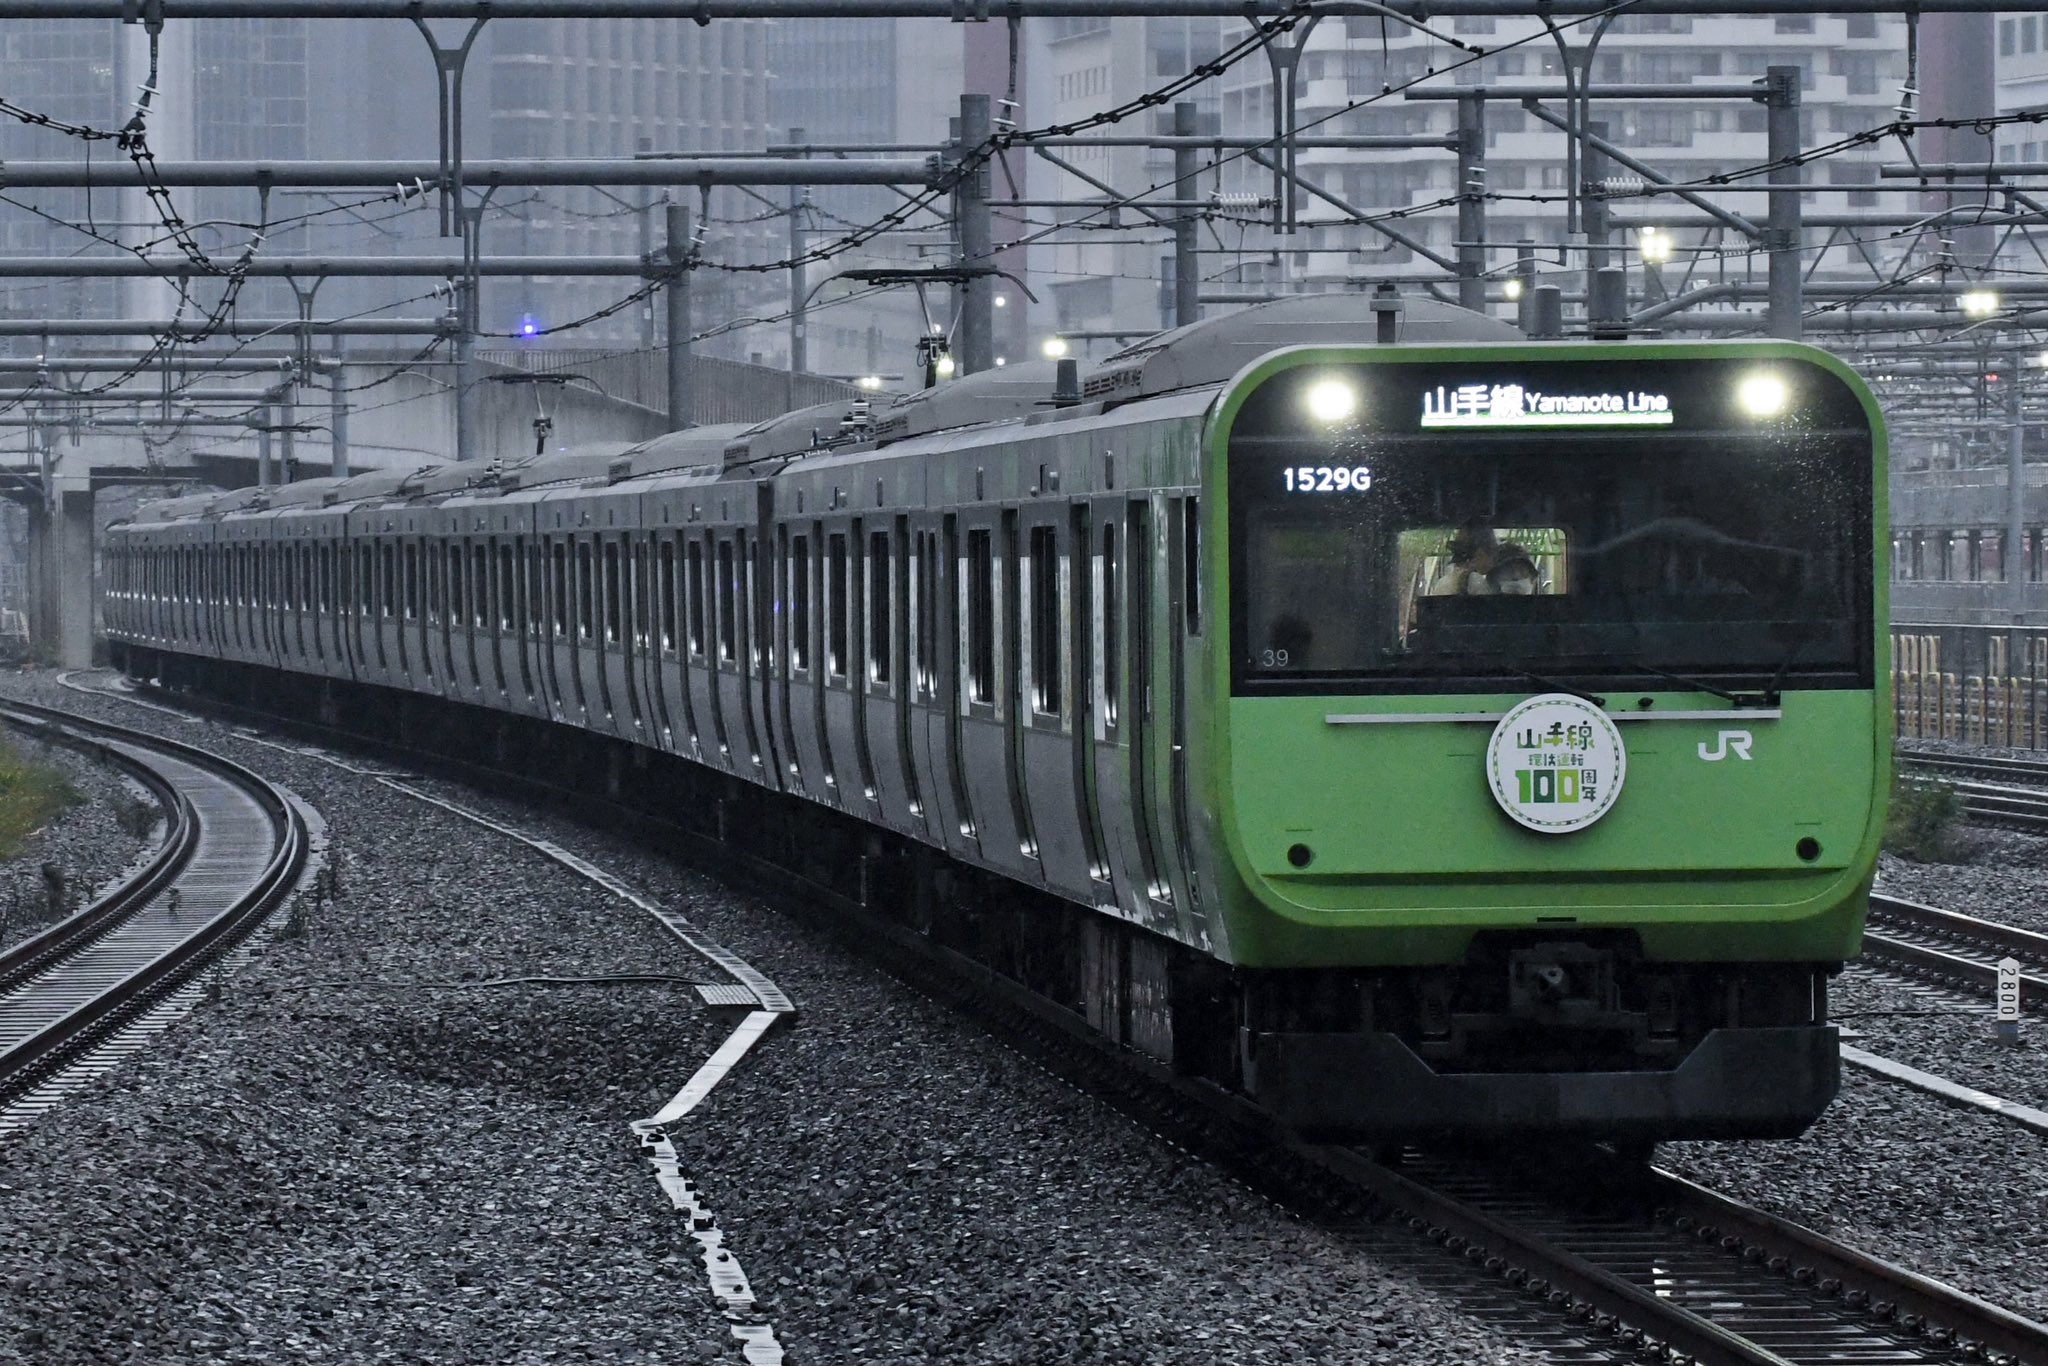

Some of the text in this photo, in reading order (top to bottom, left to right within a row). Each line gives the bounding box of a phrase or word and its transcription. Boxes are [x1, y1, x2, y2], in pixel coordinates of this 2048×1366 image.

[1424, 384, 1668, 419] 山手線 Yamanote Line
[1284, 467, 1371, 491] 1529G
[1263, 649, 1289, 667] 39
[1516, 720, 1595, 750] 山手線
[1698, 730, 1753, 761] JR
[2001, 968, 2016, 1014] 2800
